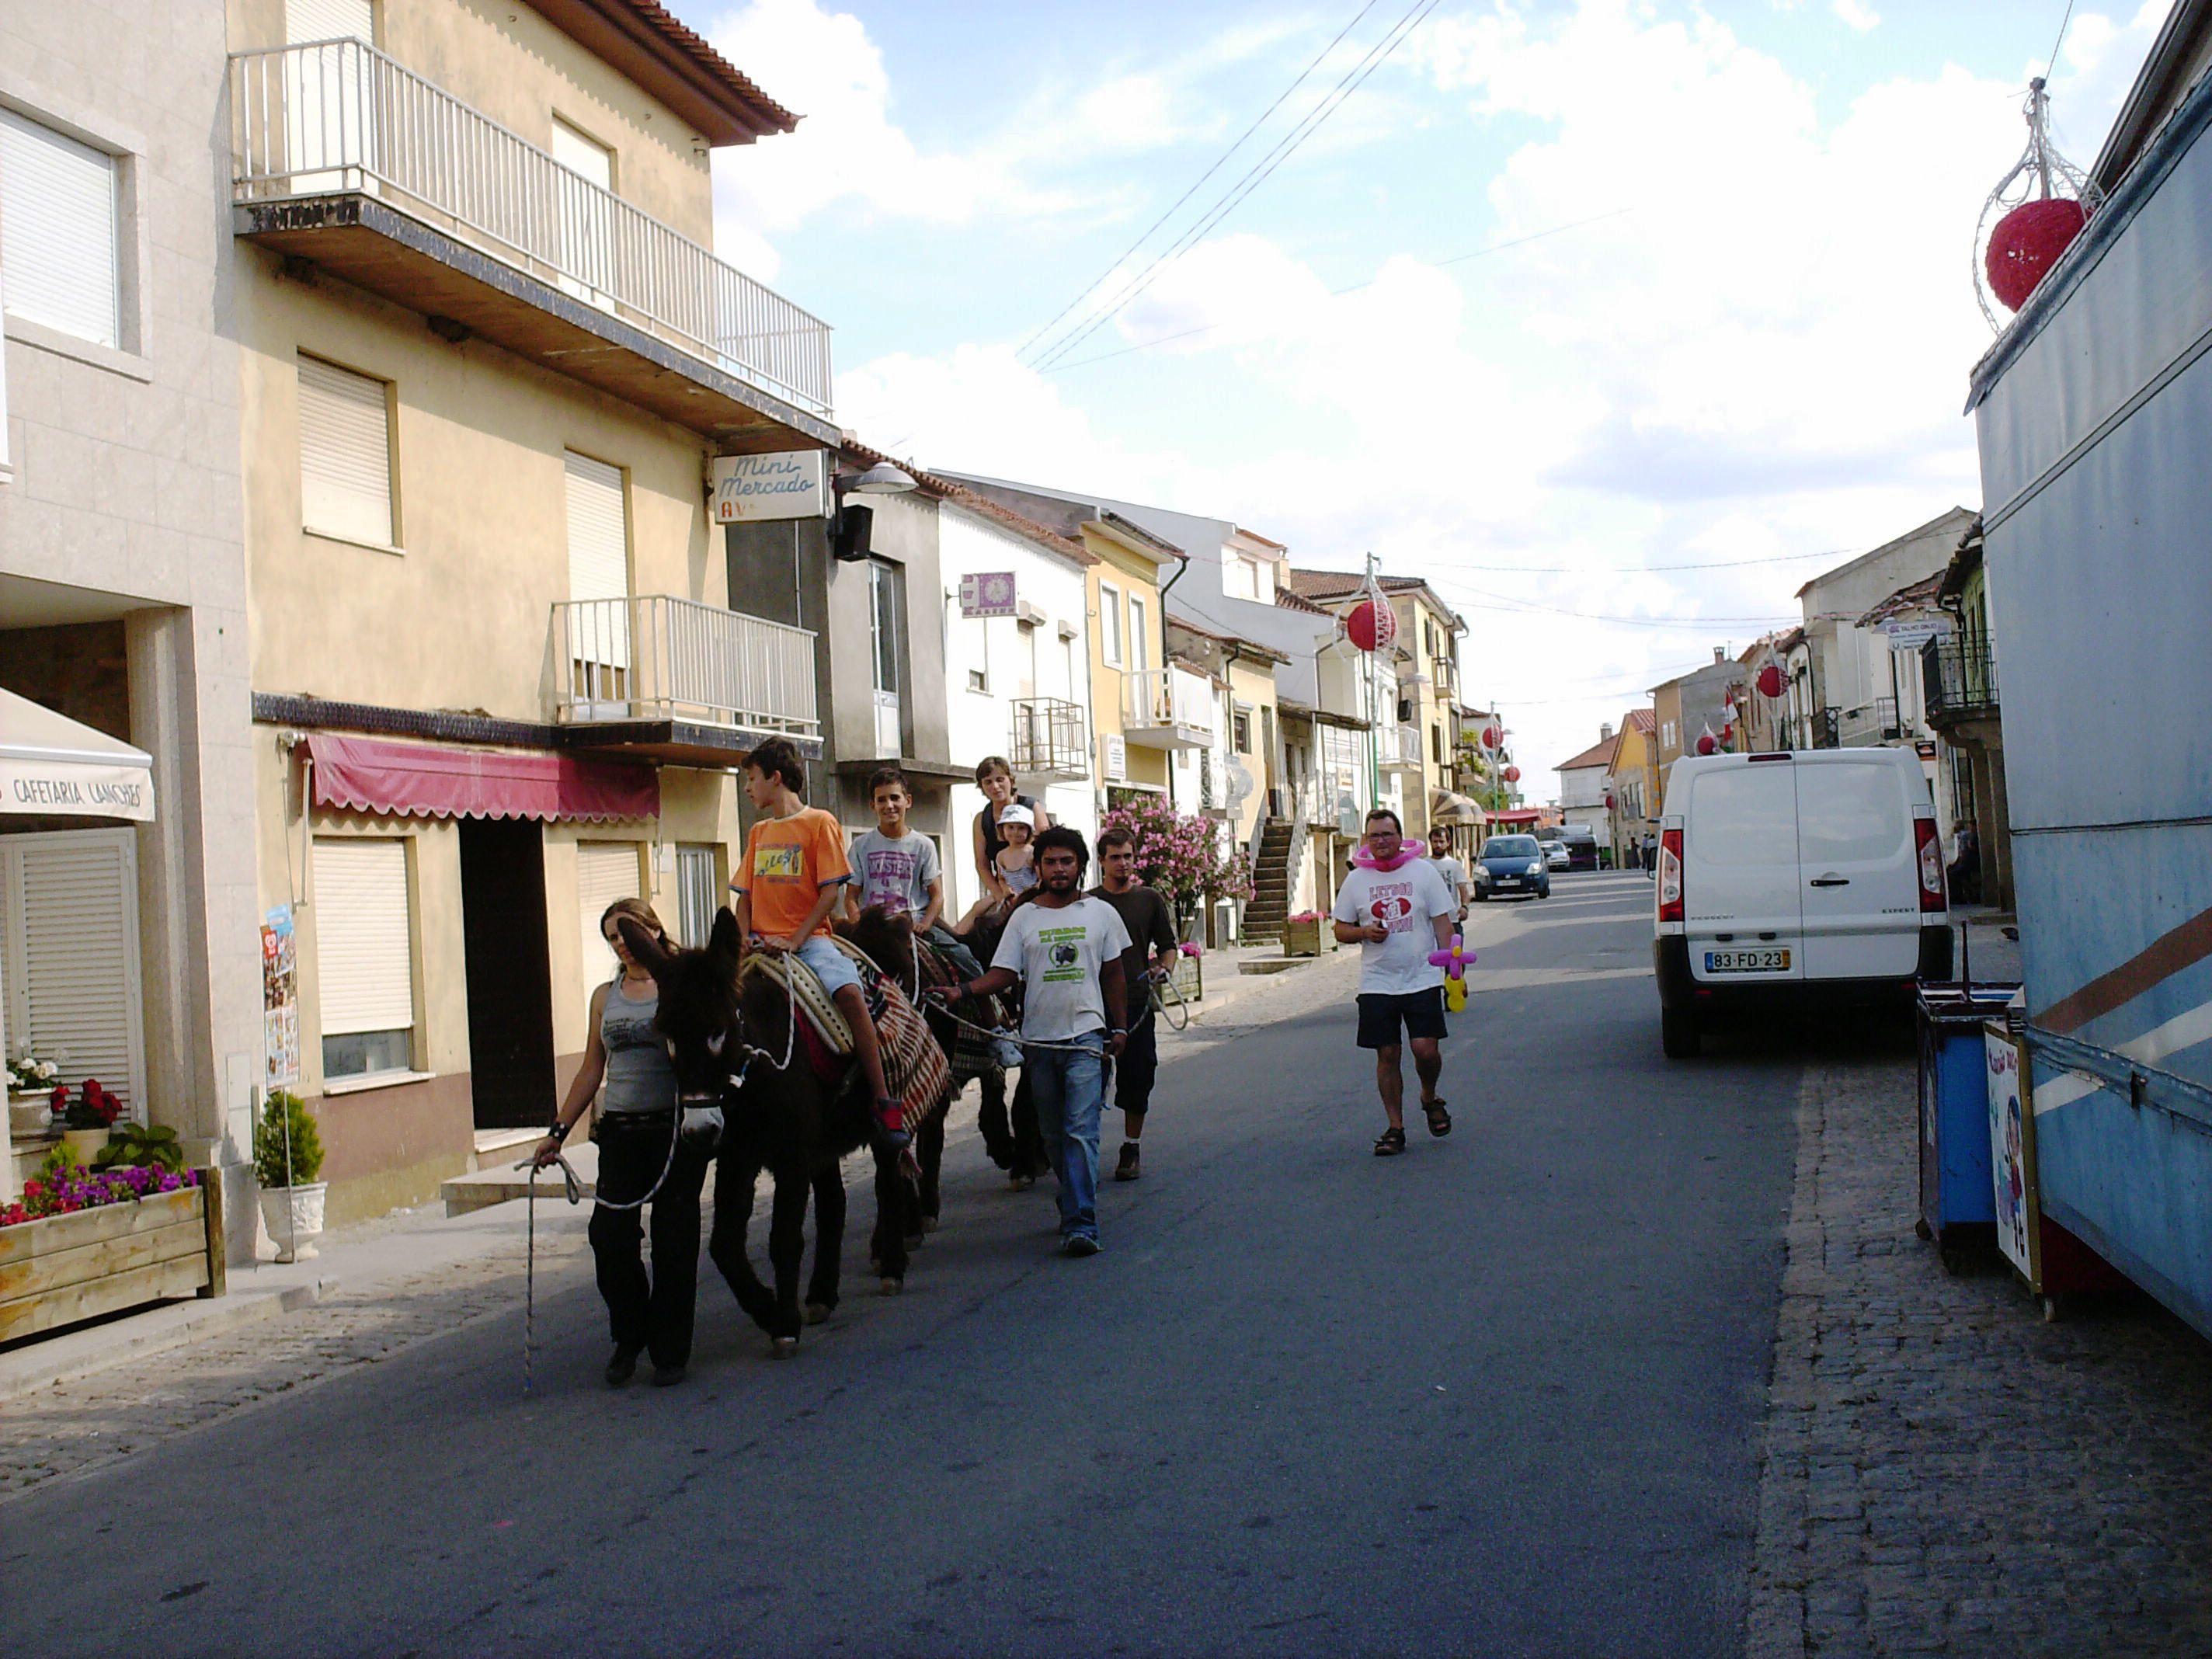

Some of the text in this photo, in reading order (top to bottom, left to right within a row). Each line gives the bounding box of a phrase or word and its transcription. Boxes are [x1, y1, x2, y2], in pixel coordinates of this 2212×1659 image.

[734, 454, 801, 476] Mini
[719, 474, 815, 497] Mercado
[13, 779, 85, 805] CAFETARIA
[87, 782, 141, 808] LANCHES
